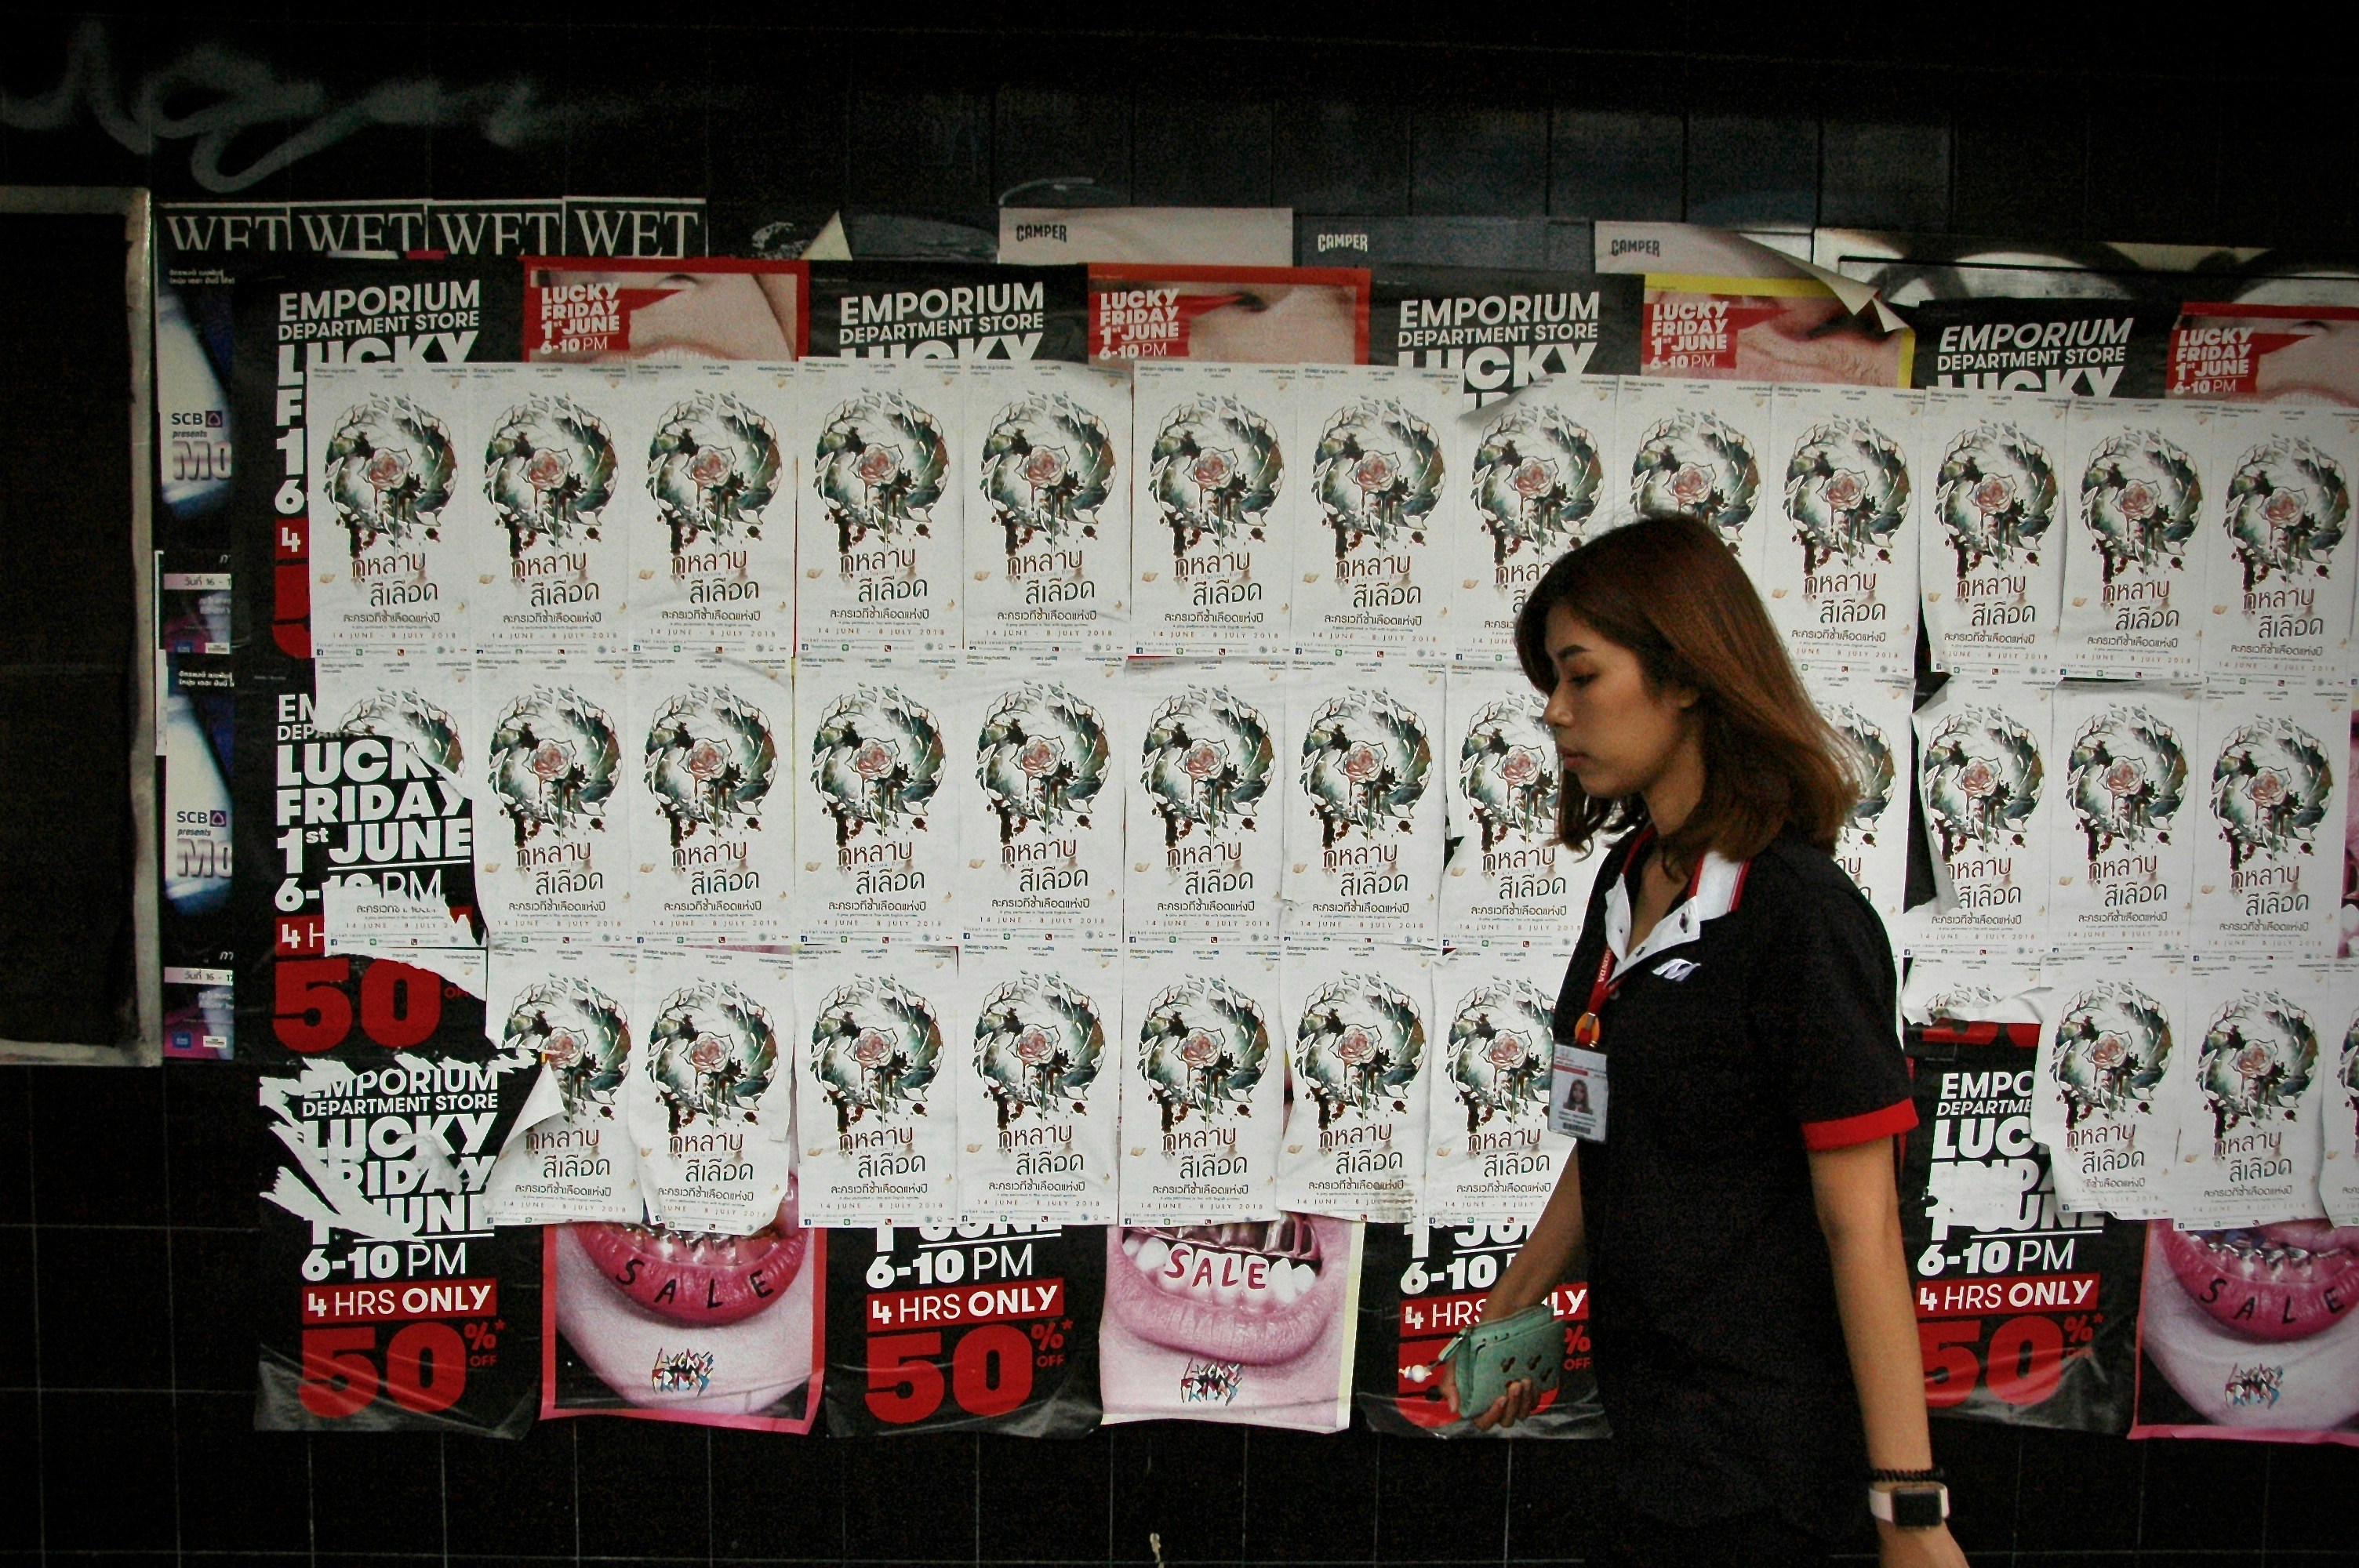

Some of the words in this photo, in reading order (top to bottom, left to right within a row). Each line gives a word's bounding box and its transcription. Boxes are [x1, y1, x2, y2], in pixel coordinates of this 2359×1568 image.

[301, 213, 422, 251] WET
[438, 212, 558, 256] WET
[575, 209, 699, 258] WET
[1016, 224, 1067, 243] CAMPER
[1318, 234, 1368, 252] CAMPER
[1611, 239, 1660, 258] CAMPER
[278, 280, 480, 321] EMPORIUM
[541, 281, 620, 305] LUCKY
[840, 282, 1044, 325] EMPORIUM
[1100, 289, 1180, 310] LUCKY
[541, 298, 620, 321] FRIDAY
[1100, 306, 1180, 327] FRIDAY
[1399, 292, 1600, 328] EMPORIUM
[1652, 301, 1730, 323] LUCKY
[278, 316, 409, 341] DEPARTMENT
[415, 310, 479, 332] STORE
[562, 314, 620, 335] JUNE
[840, 318, 973, 345] DEPARTMENT
[978, 312, 1044, 334] STORE
[1121, 321, 1180, 340] JUNE
[1398, 325, 1530, 348] DEPARTMENT
[1535, 321, 1598, 339] STORE
[1651, 318, 1728, 337] FRIDAY
[1939, 318, 2134, 353] EMPORIUM
[2179, 327, 2255, 347] LUCKY
[540, 337, 581, 355] 6-10
[582, 336, 608, 352] PM
[1099, 343, 1140, 361] 6-10
[1141, 341, 1167, 357] PM
[1671, 333, 1728, 353] JUNE
[2175, 345, 2252, 363] FRIDAY
[1649, 353, 1689, 369] 6-10
[1690, 352, 1715, 368] PM
[1937, 350, 2059, 372] DEPARTMENT
[2065, 345, 2125, 365] STORE
[2194, 358, 2249, 377] JUNE
[2211, 377, 2237, 393] PM
[171, 412, 203, 427] SCB
[172, 430, 209, 439] presents
[280, 527, 300, 552] 4
[351, 552, 424, 583] กุหลาบ
[840, 548, 914, 578] กุหลาบ
[1007, 550, 1081, 580] กุหลาบ
[1495, 561, 1554, 590] กุหล
[370, 580, 438, 607] สีเลือด
[859, 576, 927, 602] สีเลือด
[1026, 577, 1094, 604] สีเลือด
[1804, 572, 1875, 600] กุหลาบ
[2103, 579, 2169, 608] กุหลาบ
[1821, 600, 1885, 624] สีเลือด
[2117, 607, 2178, 631] สีเลือด
[277, 739, 432, 787] LUCK
[176, 810, 209, 824] SCB
[177, 827, 212, 837] presents
[277, 827, 329, 874] 1st
[328, 818, 471, 864] JUNE
[516, 841, 590, 872] กุหลาบ
[838, 840, 911, 871] กุหลาบ
[1323, 844, 1396, 873] กุหลาบ
[1482, 849, 1554, 875] กุหลาบ
[2088, 855, 2156, 884] กุหลาบ
[536, 869, 603, 895] สีเลือด
[856, 869, 924, 895] สีเลือด
[1341, 871, 1408, 896] สีเลือด
[1499, 876, 1565, 898] สีเลือด
[2105, 881, 2167, 907] สีเลือด
[282, 924, 301, 949] 4
[304, 1068, 498, 1099] MPORIUM
[1940, 1071, 2034, 1100] EMPO
[303, 1095, 430, 1118] DEPARTMENT
[434, 1092, 498, 1111] STORE
[1936, 1100, 2033, 1116] DEPARTME
[304, 1112, 498, 1160] LUCKY
[526, 1129, 598, 1156] กุหลาบ
[839, 1126, 912, 1156] กุหลาบ
[1162, 1127, 1235, 1156] กุหลาบ
[1319, 1123, 1390, 1152] กุหลาบ
[1932, 1116, 2037, 1160] LUC
[2214, 1131, 2281, 1160] กุหลาบ
[543, 1155, 609, 1178] สีเลือด
[858, 1152, 925, 1178] สีเลือด
[1180, 1153, 1247, 1178] สีเลือด
[1336, 1149, 1402, 1174] สีเลือด
[2230, 1156, 2291, 1181] สีเลือด
[301, 1245, 399, 1282] 6-10
[408, 1242, 467, 1276] PM
[865, 1250, 965, 1289] 6-10
[972, 1247, 1033, 1280] PM
[1164, 1247, 1267, 1292] SALE
[1917, 1241, 2011, 1276] 6-10
[2017, 1239, 2074, 1272] PM
[616, 1258, 775, 1309] SALE
[1400, 1255, 1497, 1294] 6-10
[307, 1294, 327, 1317] 4
[334, 1290, 396, 1316] HRS
[402, 1284, 492, 1314] ONLY
[871, 1299, 892, 1325] 4
[900, 1294, 961, 1322] HRS
[968, 1285, 1058, 1317] ONLY
[1918, 1287, 1938, 1311] 4
[1944, 1283, 2002, 1309] HRS
[2008, 1279, 2093, 1308] ONLY
[2199, 1279, 2346, 1325] SALE
[1405, 1305, 1424, 1330] 4
[468, 1354, 498, 1369] OFF
[1037, 1354, 1065, 1369] OFF
[1563, 1357, 1591, 1370] OFF
